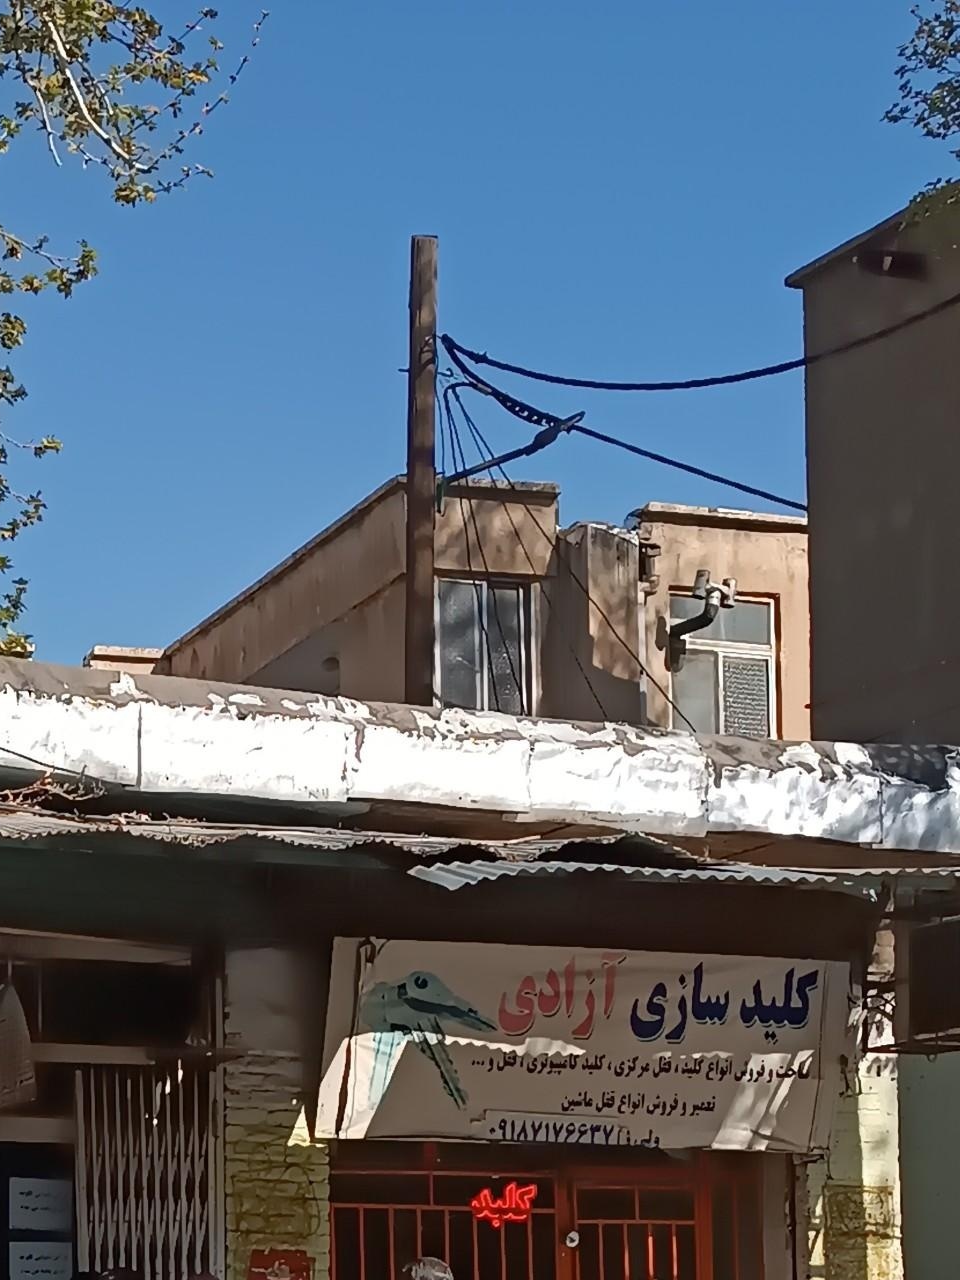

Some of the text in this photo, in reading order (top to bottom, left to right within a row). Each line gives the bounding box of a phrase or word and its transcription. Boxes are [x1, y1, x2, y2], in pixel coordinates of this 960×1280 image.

[497, 951, 820, 1045] کلید سازی آزادی
[581, 1053, 606, 1075] کلید
[652, 1056, 672, 1078] قفل
[705, 1059, 733, 1081] انواع
[734, 1059, 766, 1083] فروش
[766, 1068, 774, 1083] و
[561, 1091, 716, 1116] تعمیر و فروش انواع قفل ماشین
[471, 1182, 538, 1228] کلید
